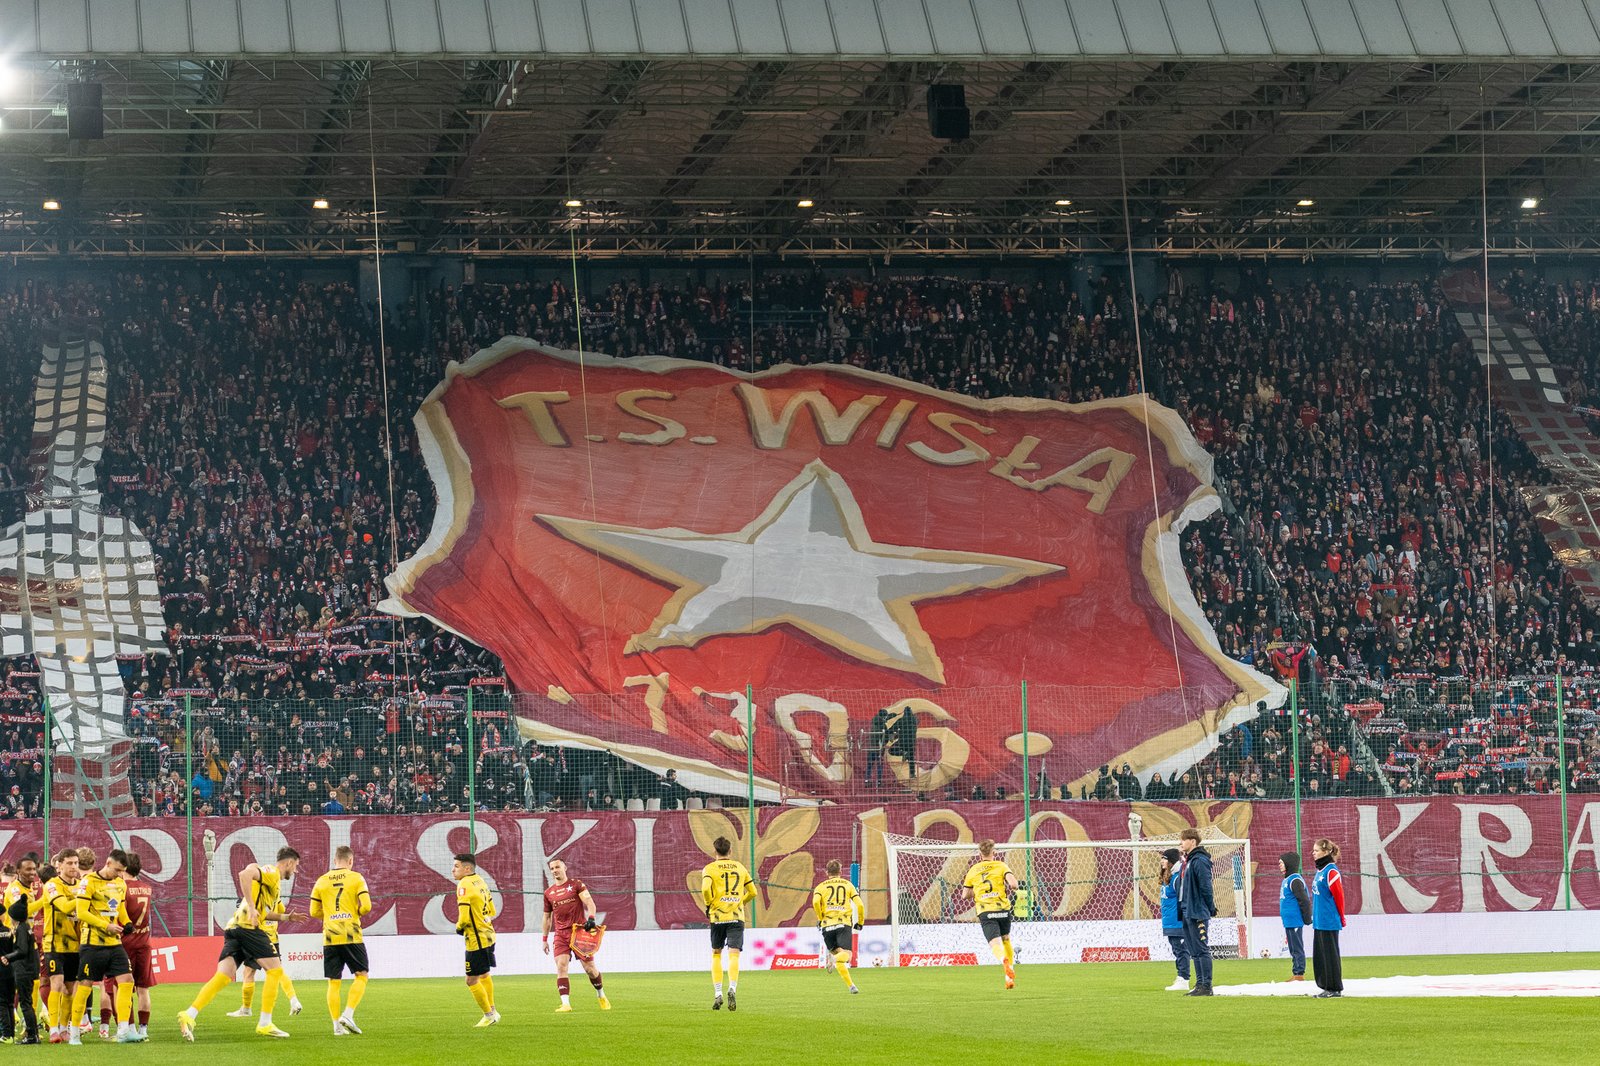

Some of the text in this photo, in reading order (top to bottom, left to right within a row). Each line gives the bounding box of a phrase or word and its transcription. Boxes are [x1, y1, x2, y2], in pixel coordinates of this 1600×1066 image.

[734, 382, 1137, 514] WISŁA
[853, 806, 1097, 925] 120
[721, 871, 739, 895] 12
[981, 872, 993, 893] 5
[333, 883, 344, 911] 7
[826, 886, 846, 905] 20
[136, 897, 149, 926] 7
[49, 960, 56, 972] 9
[909, 955, 955, 966] Betclic
